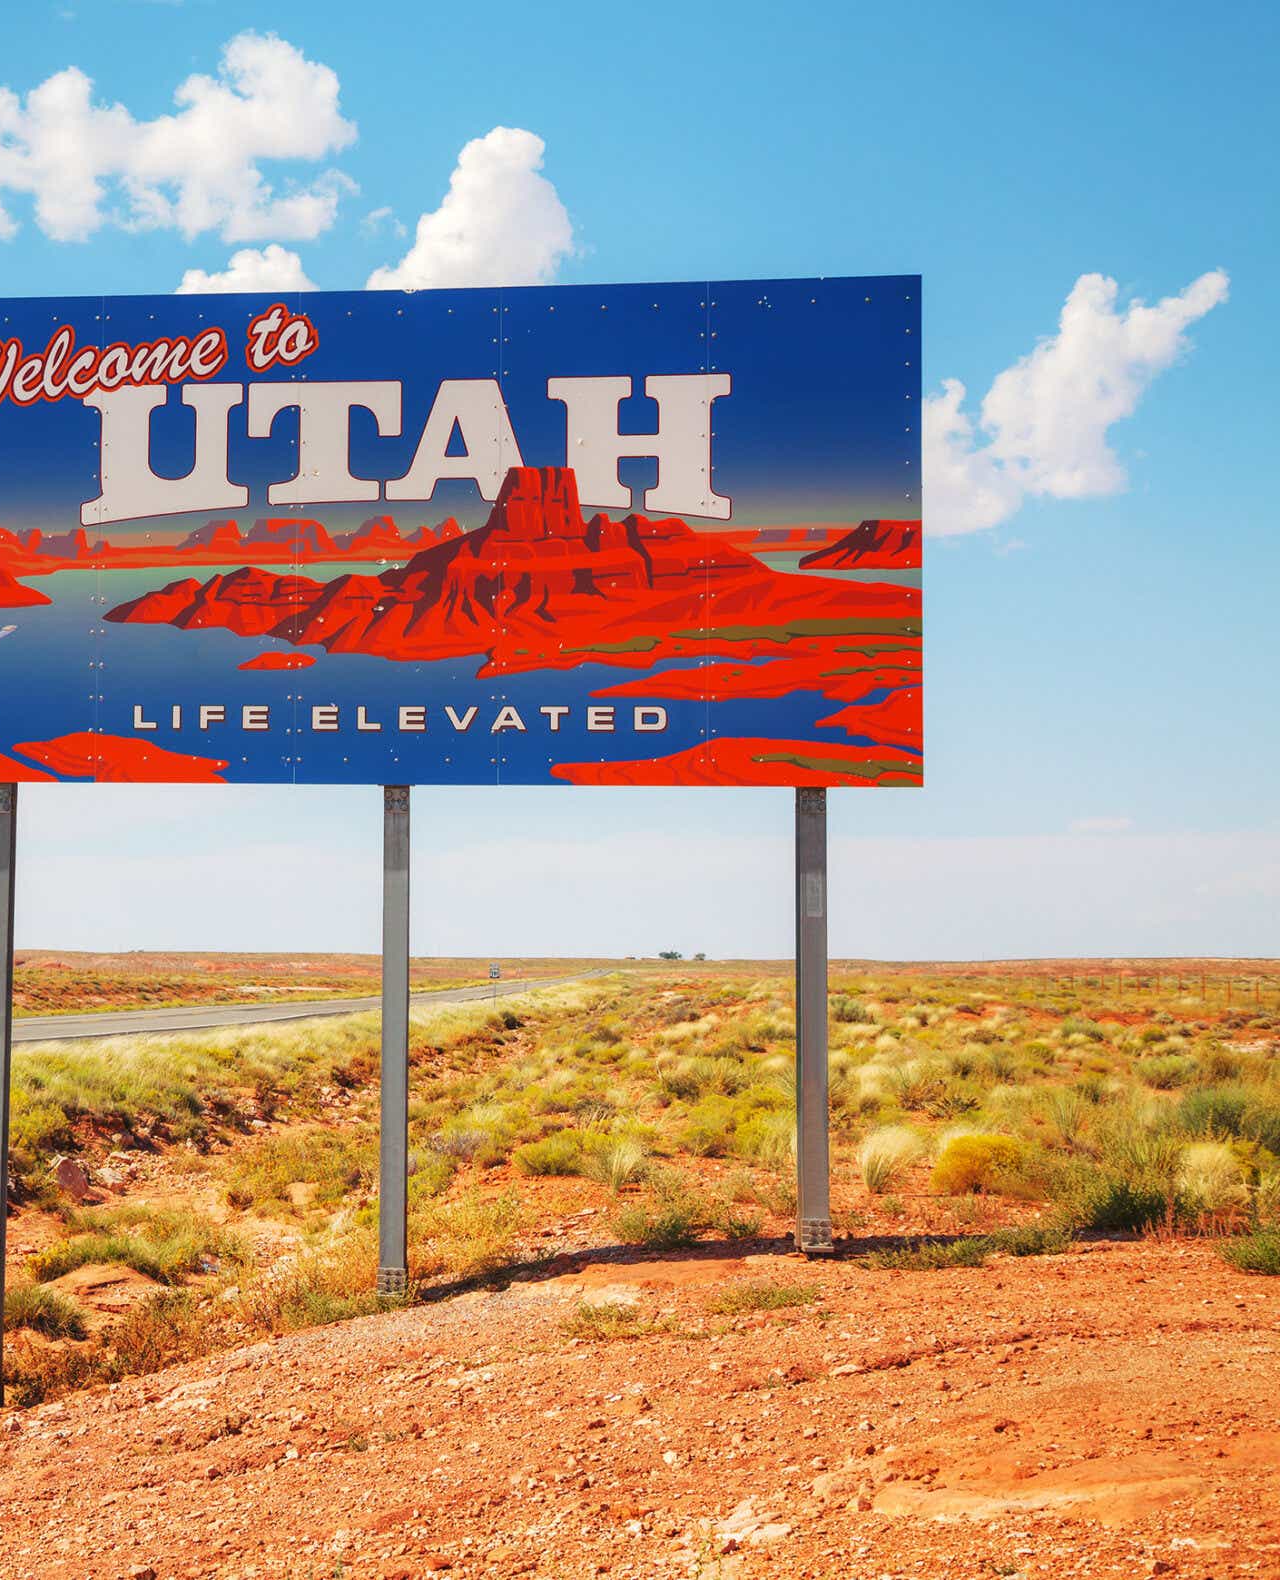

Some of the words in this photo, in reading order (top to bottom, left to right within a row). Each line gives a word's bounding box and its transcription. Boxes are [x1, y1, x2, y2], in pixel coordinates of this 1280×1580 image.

[246, 303, 318, 371] to
[80, 373, 732, 526] UTAH
[133, 704, 270, 731] LIFE
[311, 704, 669, 732] ELEVATED
